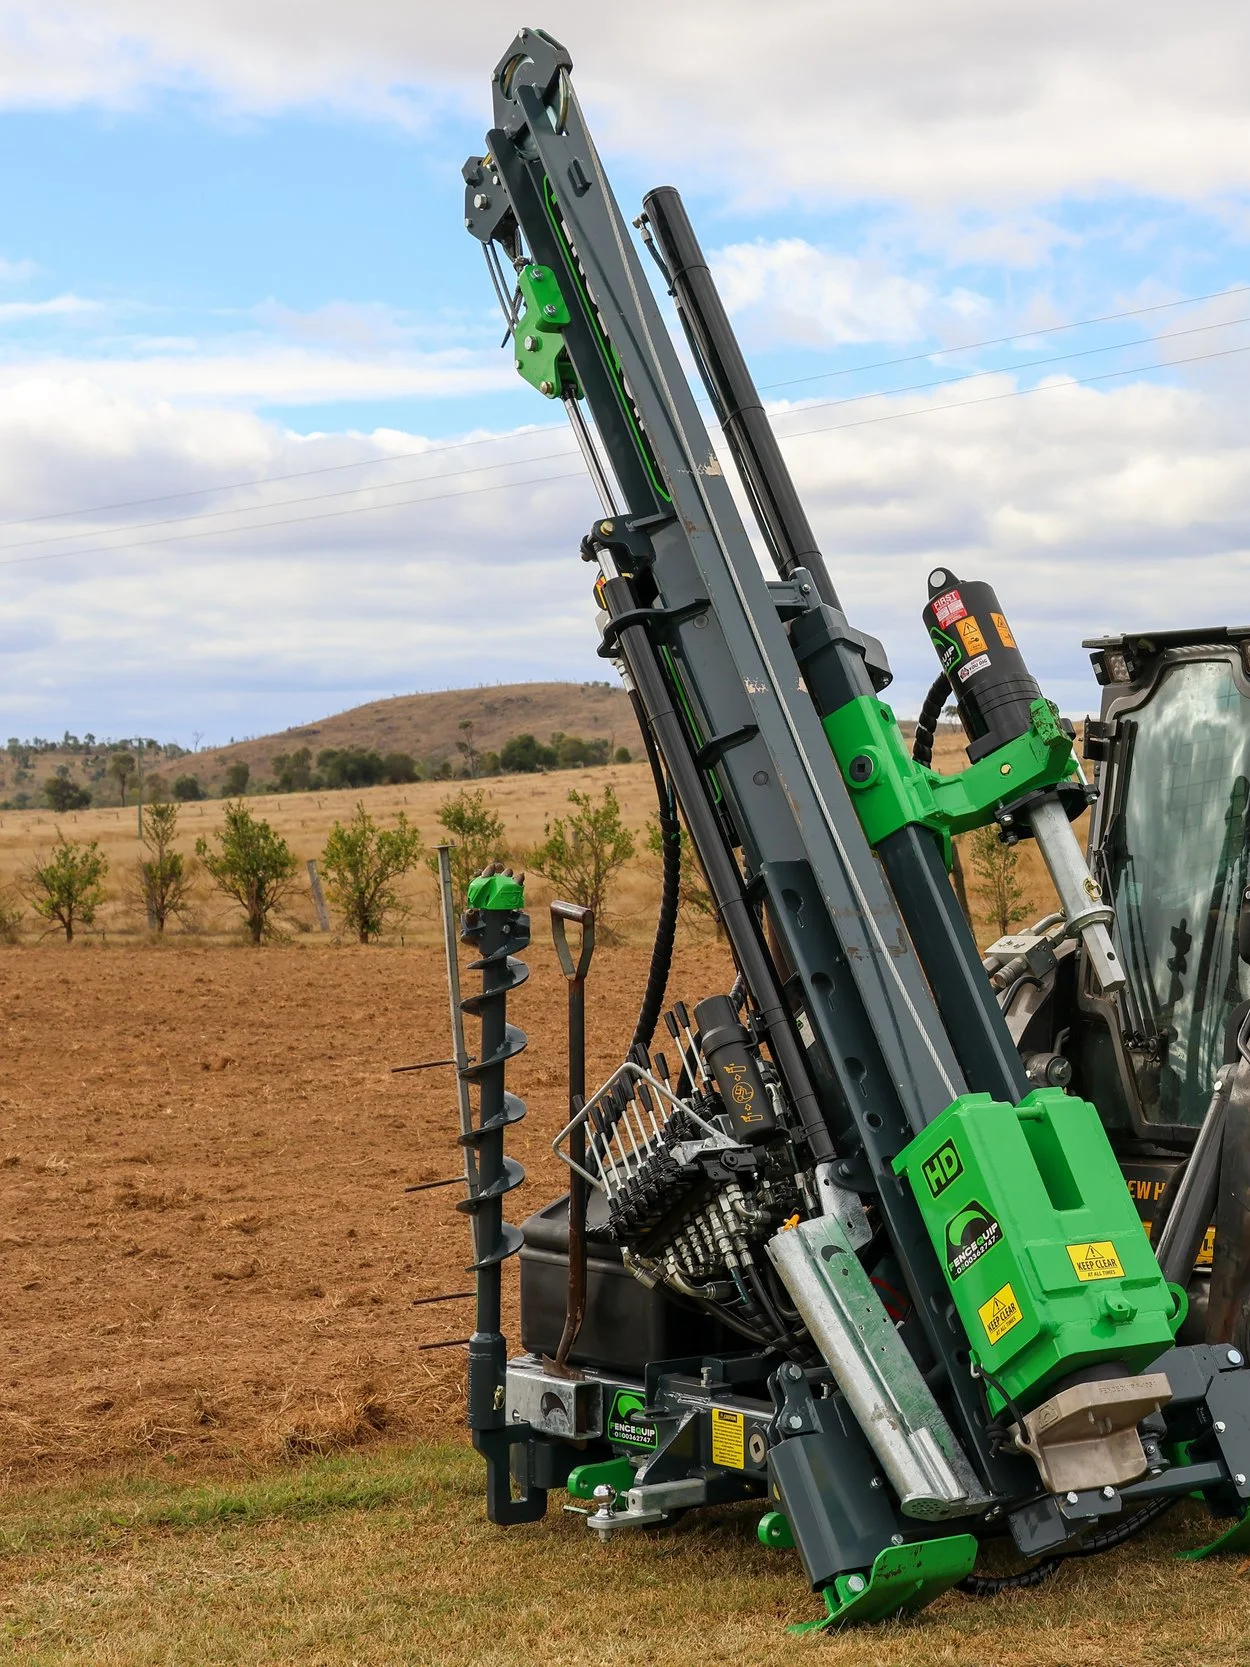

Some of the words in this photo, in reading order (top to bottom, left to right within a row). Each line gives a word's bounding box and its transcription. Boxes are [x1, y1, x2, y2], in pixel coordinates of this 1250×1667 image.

[933, 591, 956, 609] FIRST
[924, 1146, 959, 1193] HD
[1127, 1180, 1152, 1200] EW
[948, 1221, 999, 1272] FENCEQUIP
[1076, 1260, 1094, 1271] KEEP
[1095, 1258, 1118, 1269] CLEAR
[987, 1316, 1000, 1332] KEEP
[1000, 1302, 1017, 1321] CLEAR
[610, 1421, 656, 1437] FENCEQUIP
